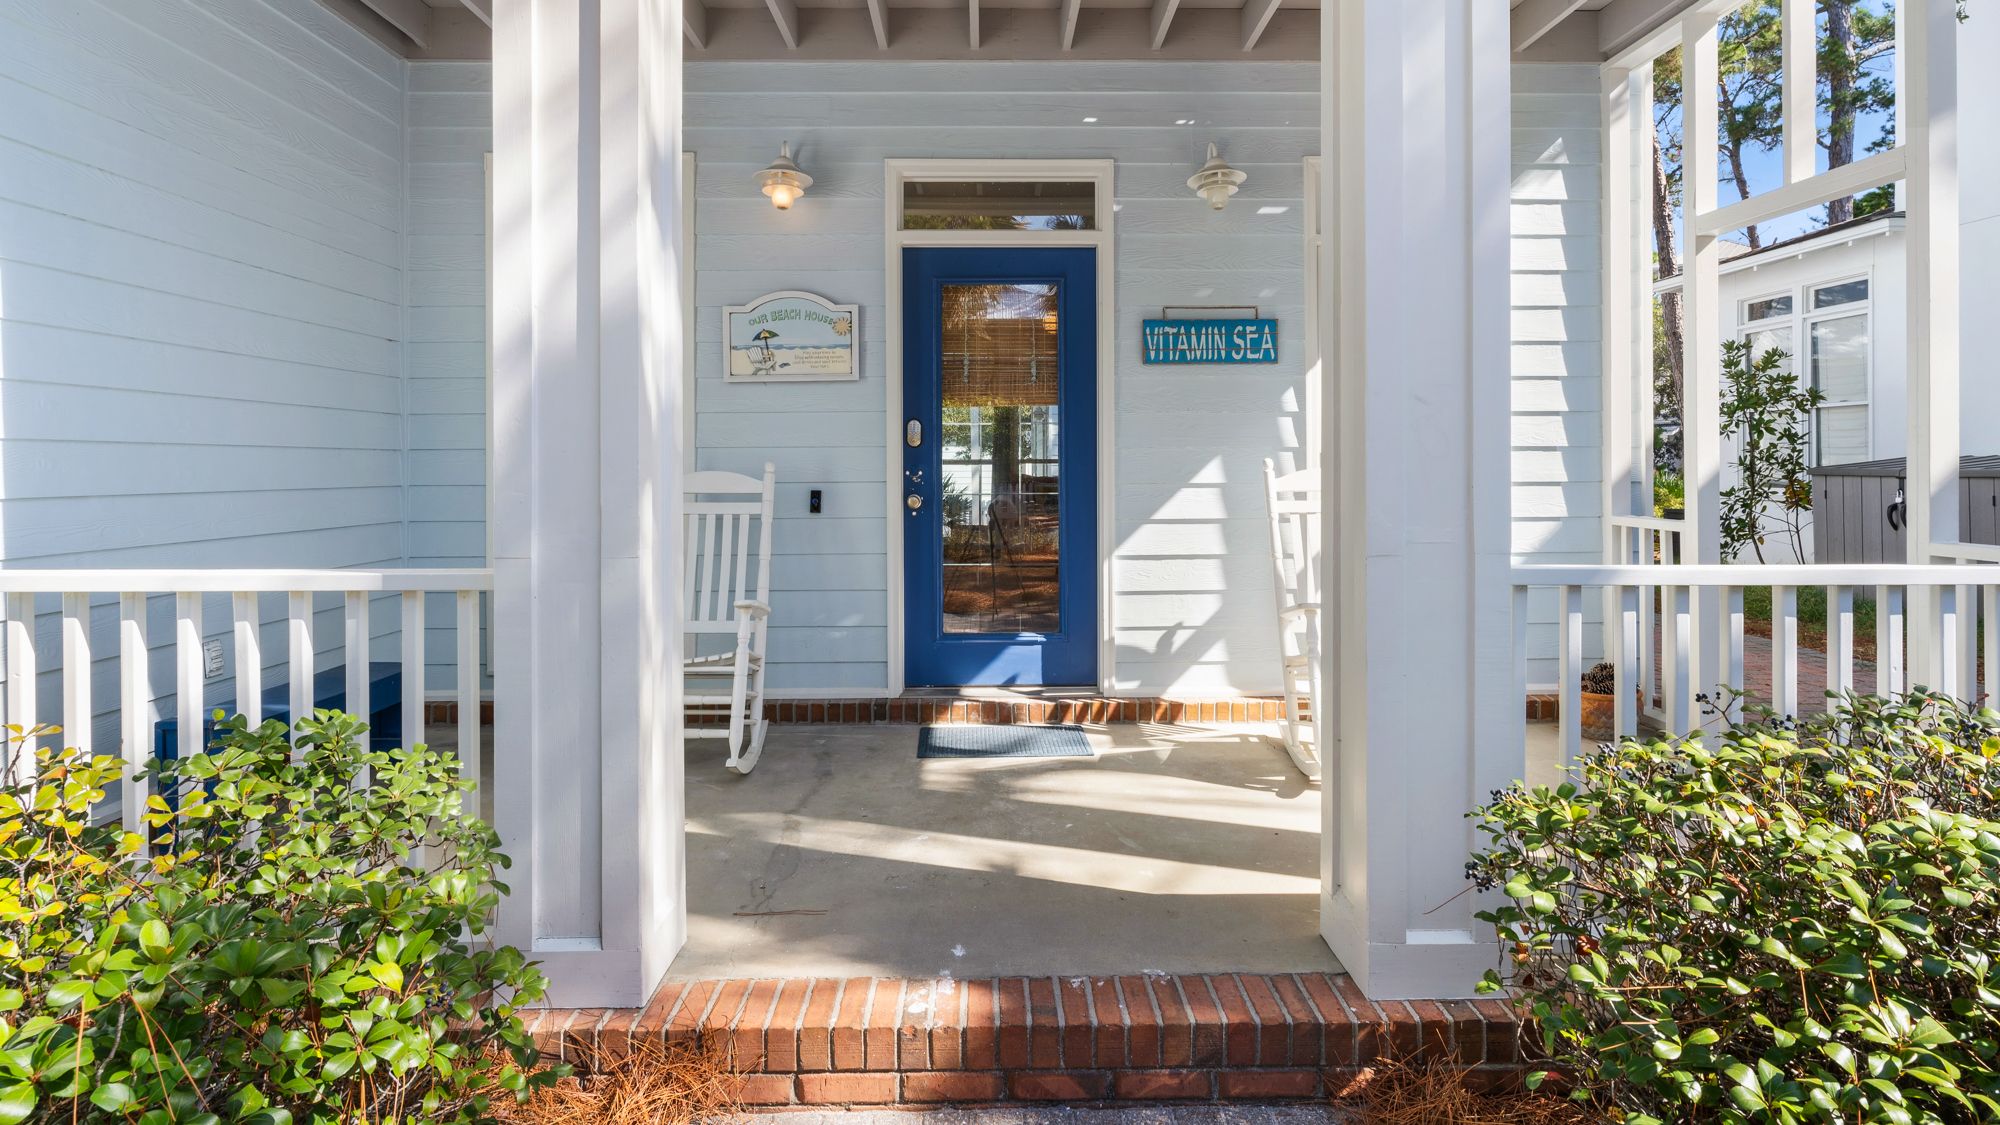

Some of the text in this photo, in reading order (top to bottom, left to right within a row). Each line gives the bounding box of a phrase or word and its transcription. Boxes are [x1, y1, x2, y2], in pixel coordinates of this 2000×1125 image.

[748, 308, 834, 326] OUR BEACH HOUSE
[1145, 324, 1275, 361] VITAMIN SEA
